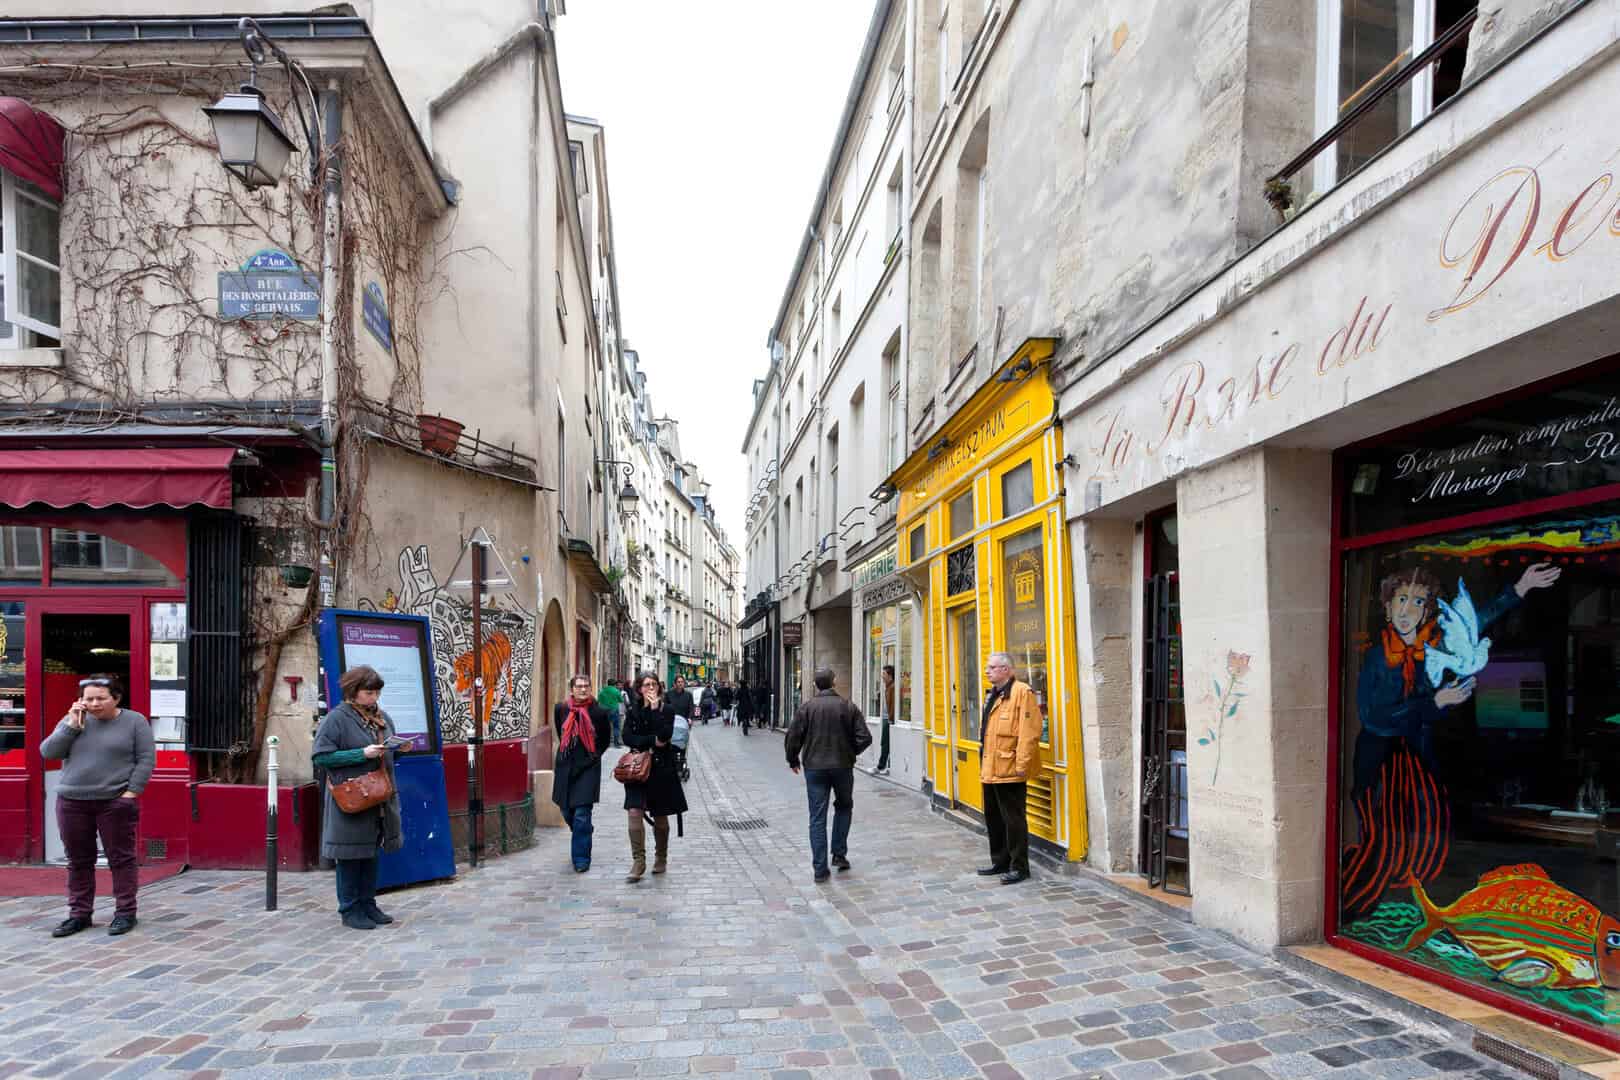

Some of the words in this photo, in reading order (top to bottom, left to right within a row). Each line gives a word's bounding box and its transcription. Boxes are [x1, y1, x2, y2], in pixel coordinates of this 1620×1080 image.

[222, 291, 239, 301] DES
[257, 279, 283, 289] RUE
[1316, 296, 1392, 376] du
[1411, 463, 1527, 503] Mariages
[853, 554, 895, 591] LAVERIE
